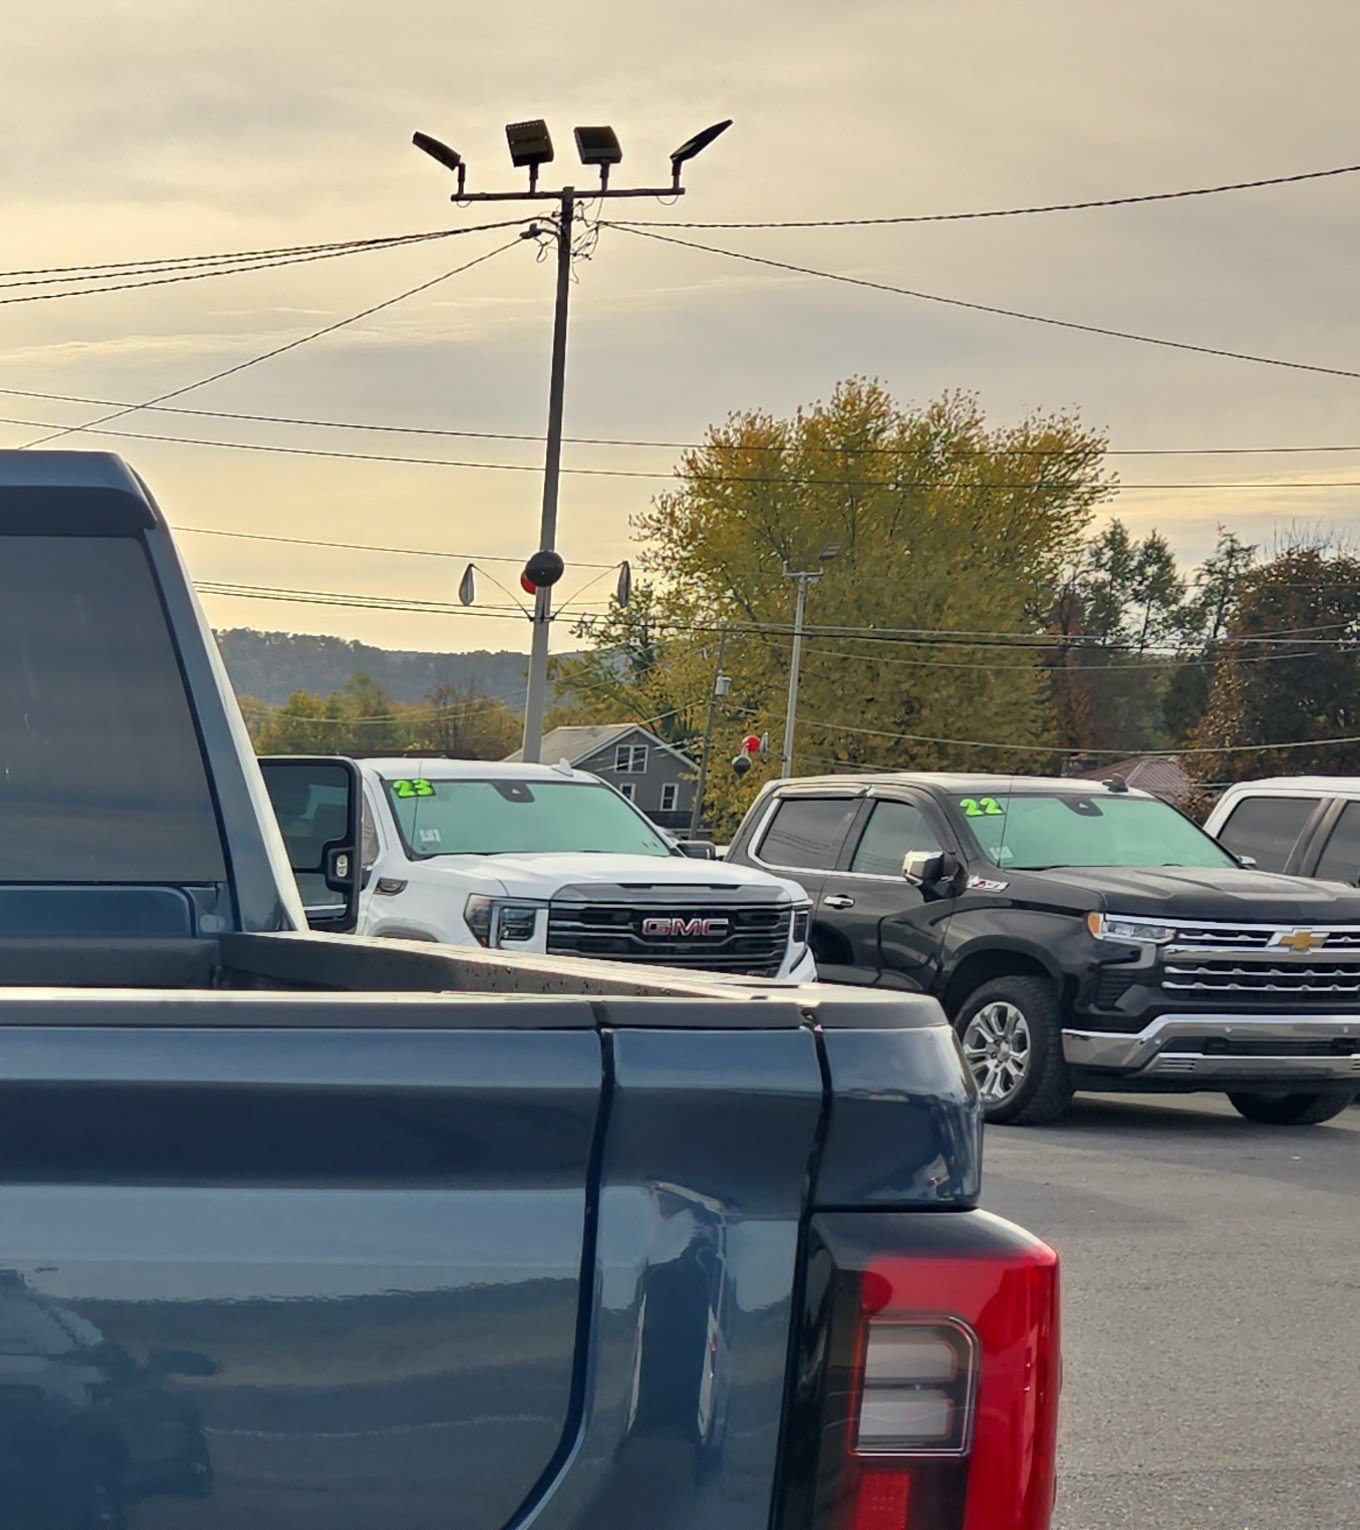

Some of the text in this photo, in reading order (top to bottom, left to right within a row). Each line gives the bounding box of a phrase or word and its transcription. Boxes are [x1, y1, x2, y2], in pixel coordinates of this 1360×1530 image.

[392, 779, 433, 796] 23
[959, 797, 1003, 815] 22
[642, 918, 729, 936] GMC
